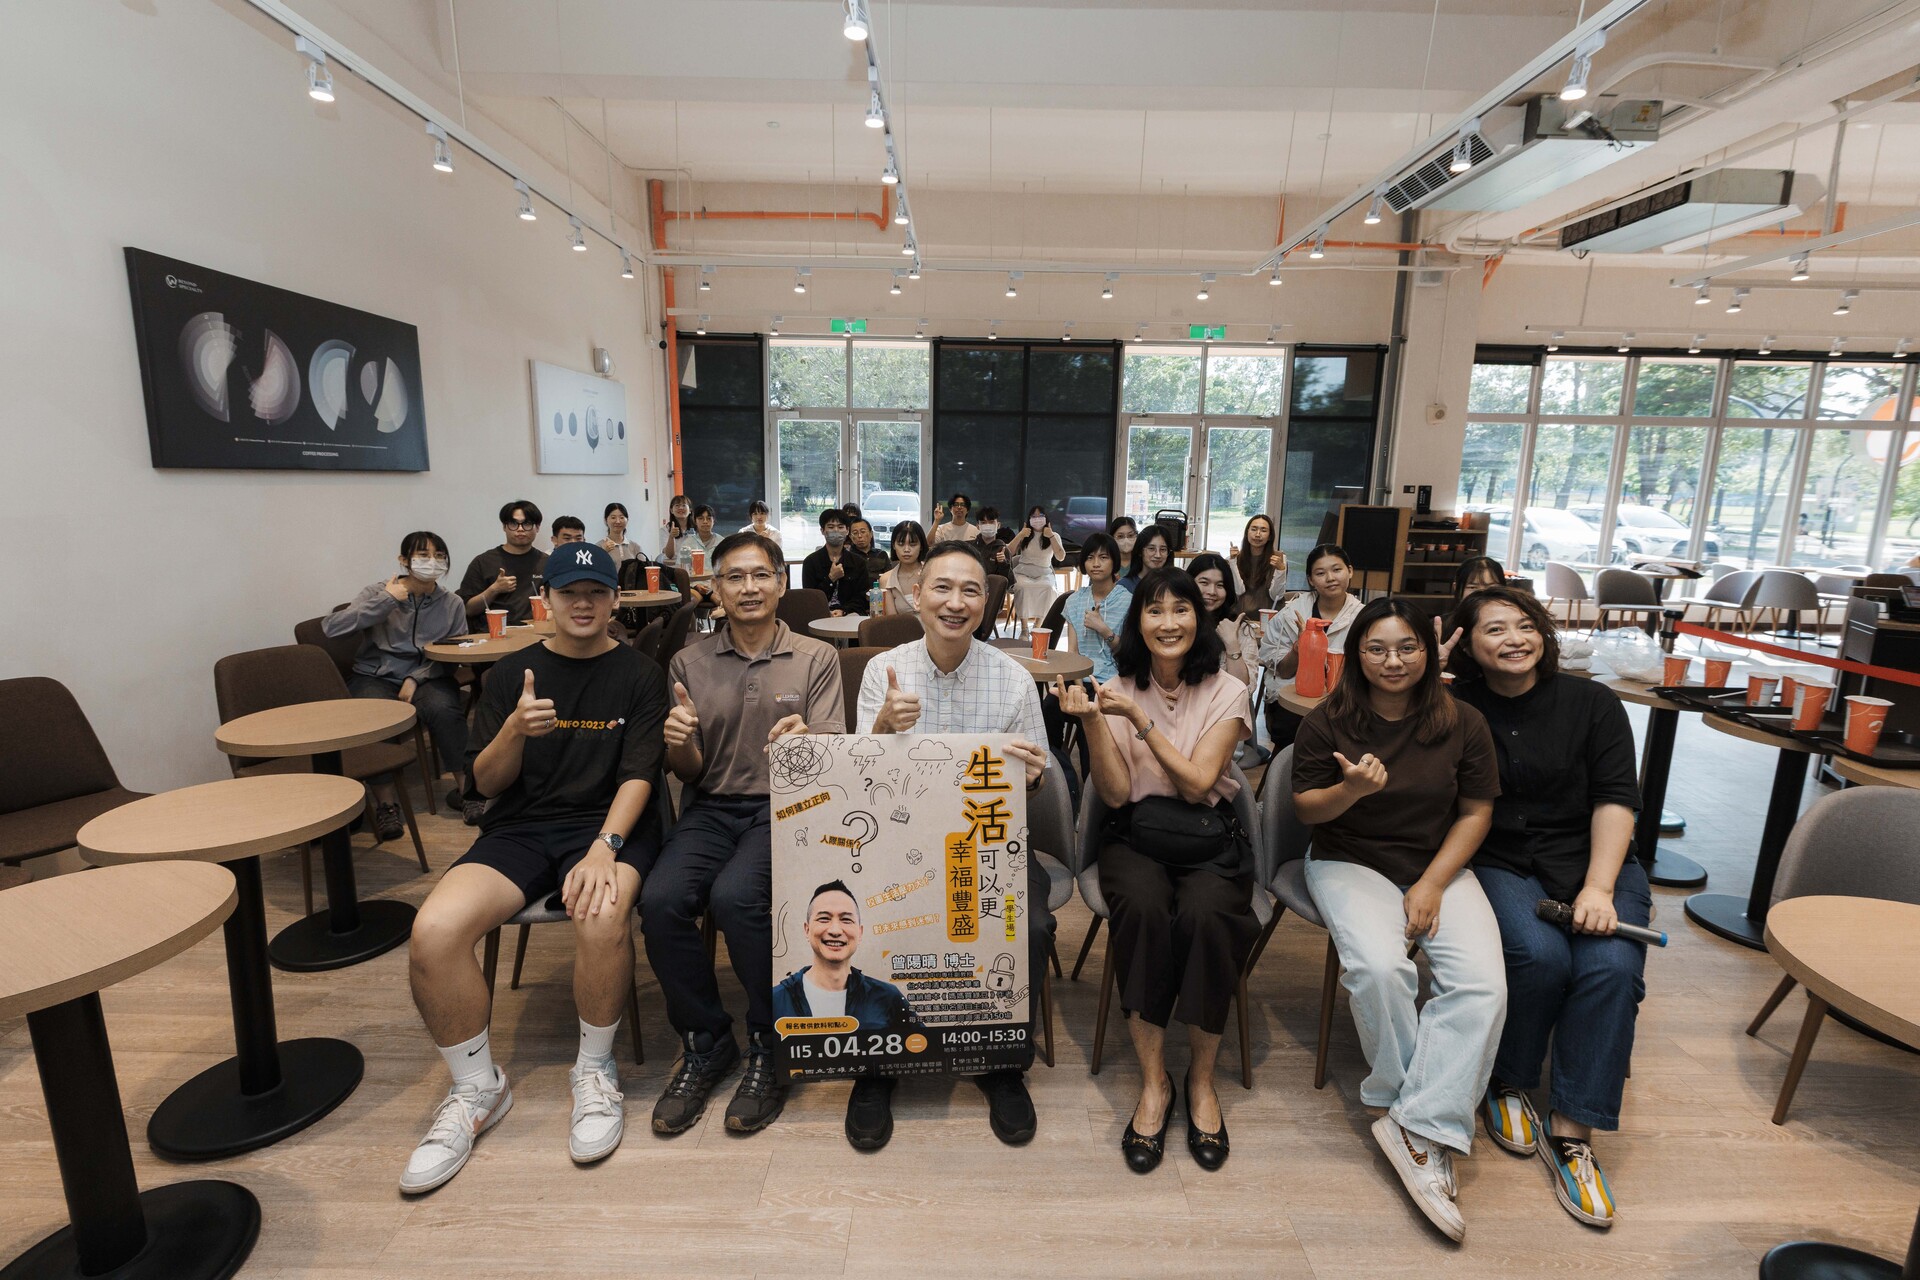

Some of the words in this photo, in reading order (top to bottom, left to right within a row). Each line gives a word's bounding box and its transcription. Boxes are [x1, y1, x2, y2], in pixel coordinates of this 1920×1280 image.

[576, 549, 593, 565] NY
[581, 720, 605, 729] 2023
[962, 746, 1012, 844] 生活
[776, 792, 830, 820] 如何建立正向
[949, 840, 975, 937] 幸福豐盛
[977, 849, 1002, 919] 可以更
[891, 954, 938, 970] 曾陽晴
[944, 953, 975, 968] 博士
[785, 1021, 849, 1030] 報名者供飲料和點心
[942, 1028, 1026, 1044] 14:00-15:30
